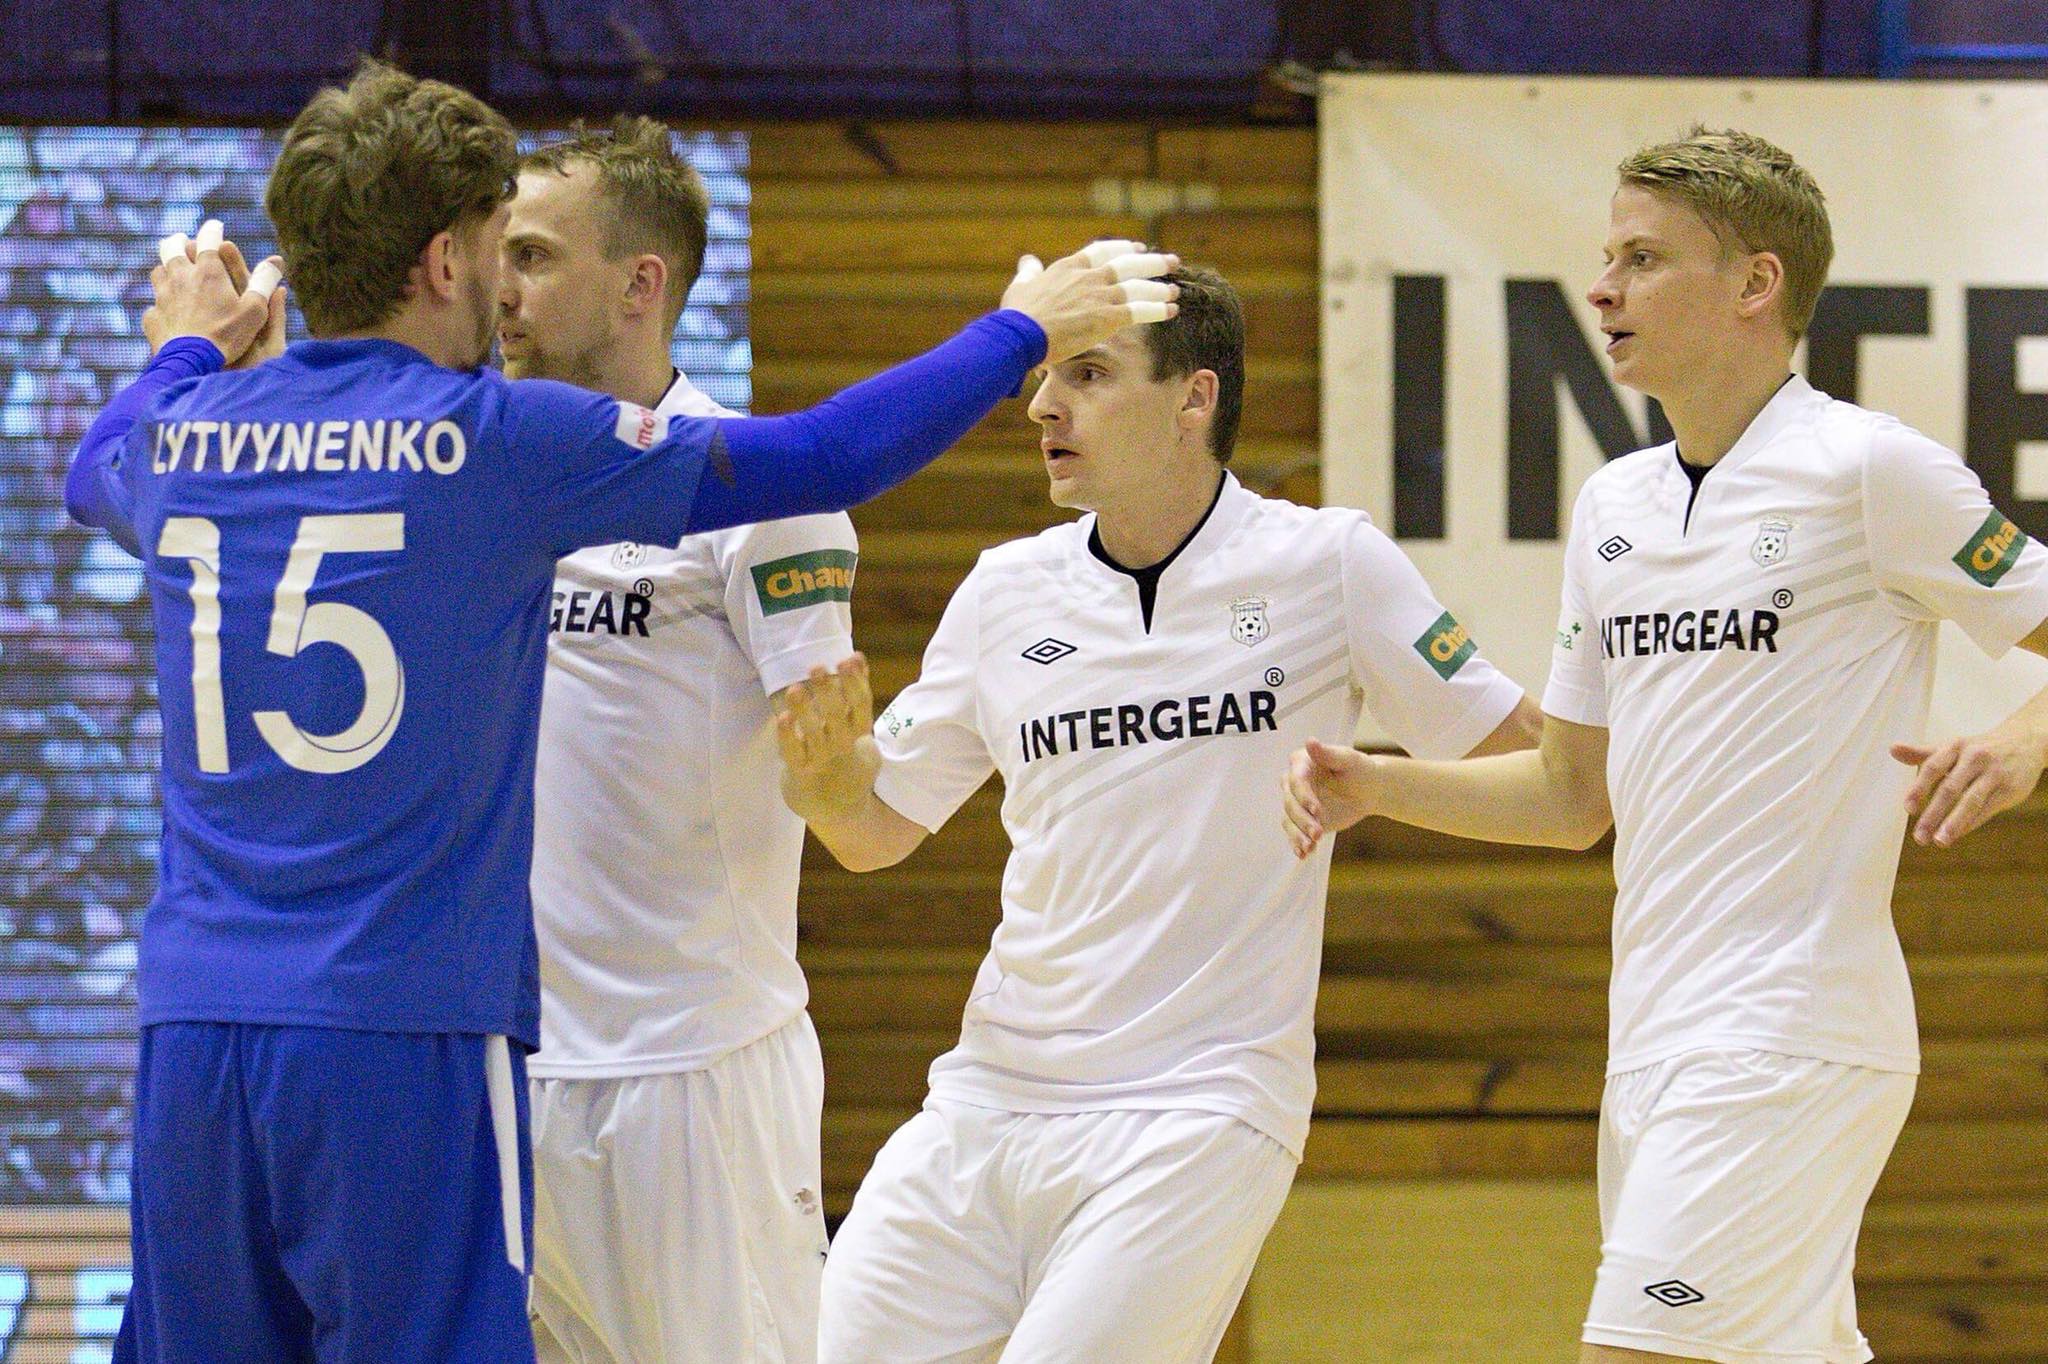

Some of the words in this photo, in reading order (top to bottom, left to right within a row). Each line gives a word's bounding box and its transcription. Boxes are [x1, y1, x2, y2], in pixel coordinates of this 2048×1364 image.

[153, 420, 466, 476] LYTVYNENKO
[157, 512, 406, 774] 15
[1021, 690, 1279, 763] INTERGEAR
